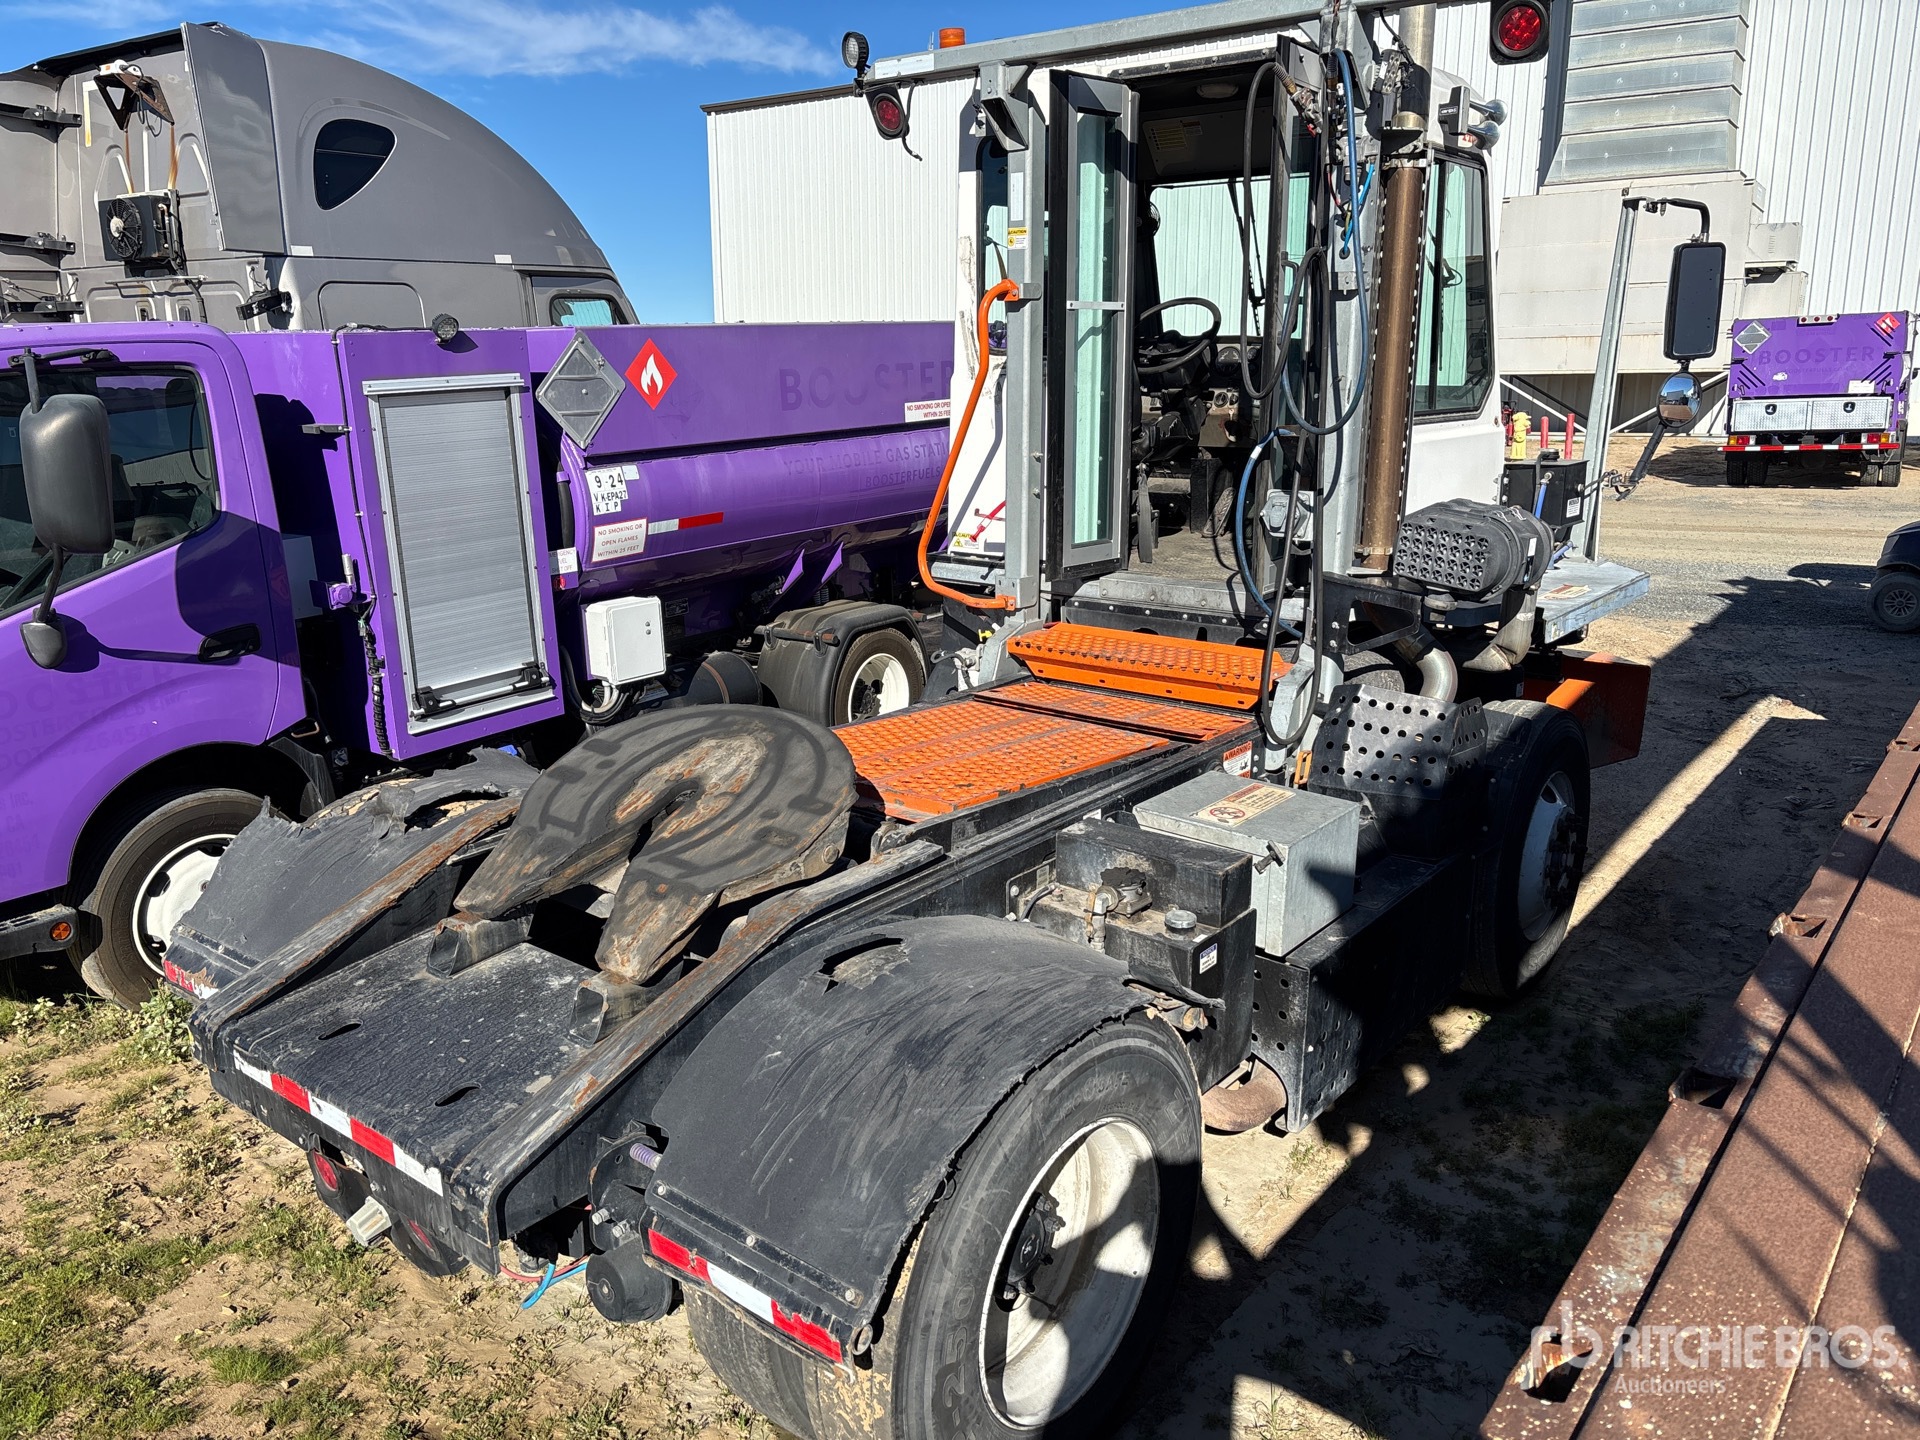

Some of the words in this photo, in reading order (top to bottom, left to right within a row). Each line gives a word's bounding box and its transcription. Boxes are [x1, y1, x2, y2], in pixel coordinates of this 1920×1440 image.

[1759, 346, 1875, 365] BOOSTER
[914, 402, 933, 411] SMOKING
[886, 446, 910, 462] GAS
[915, 442, 950, 459] STATI
[608, 525, 634, 535] SMOKING
[601, 539, 617, 547] OPEN
[618, 535, 639, 544] FLAMES
[598, 549, 618, 558] WITHIN
